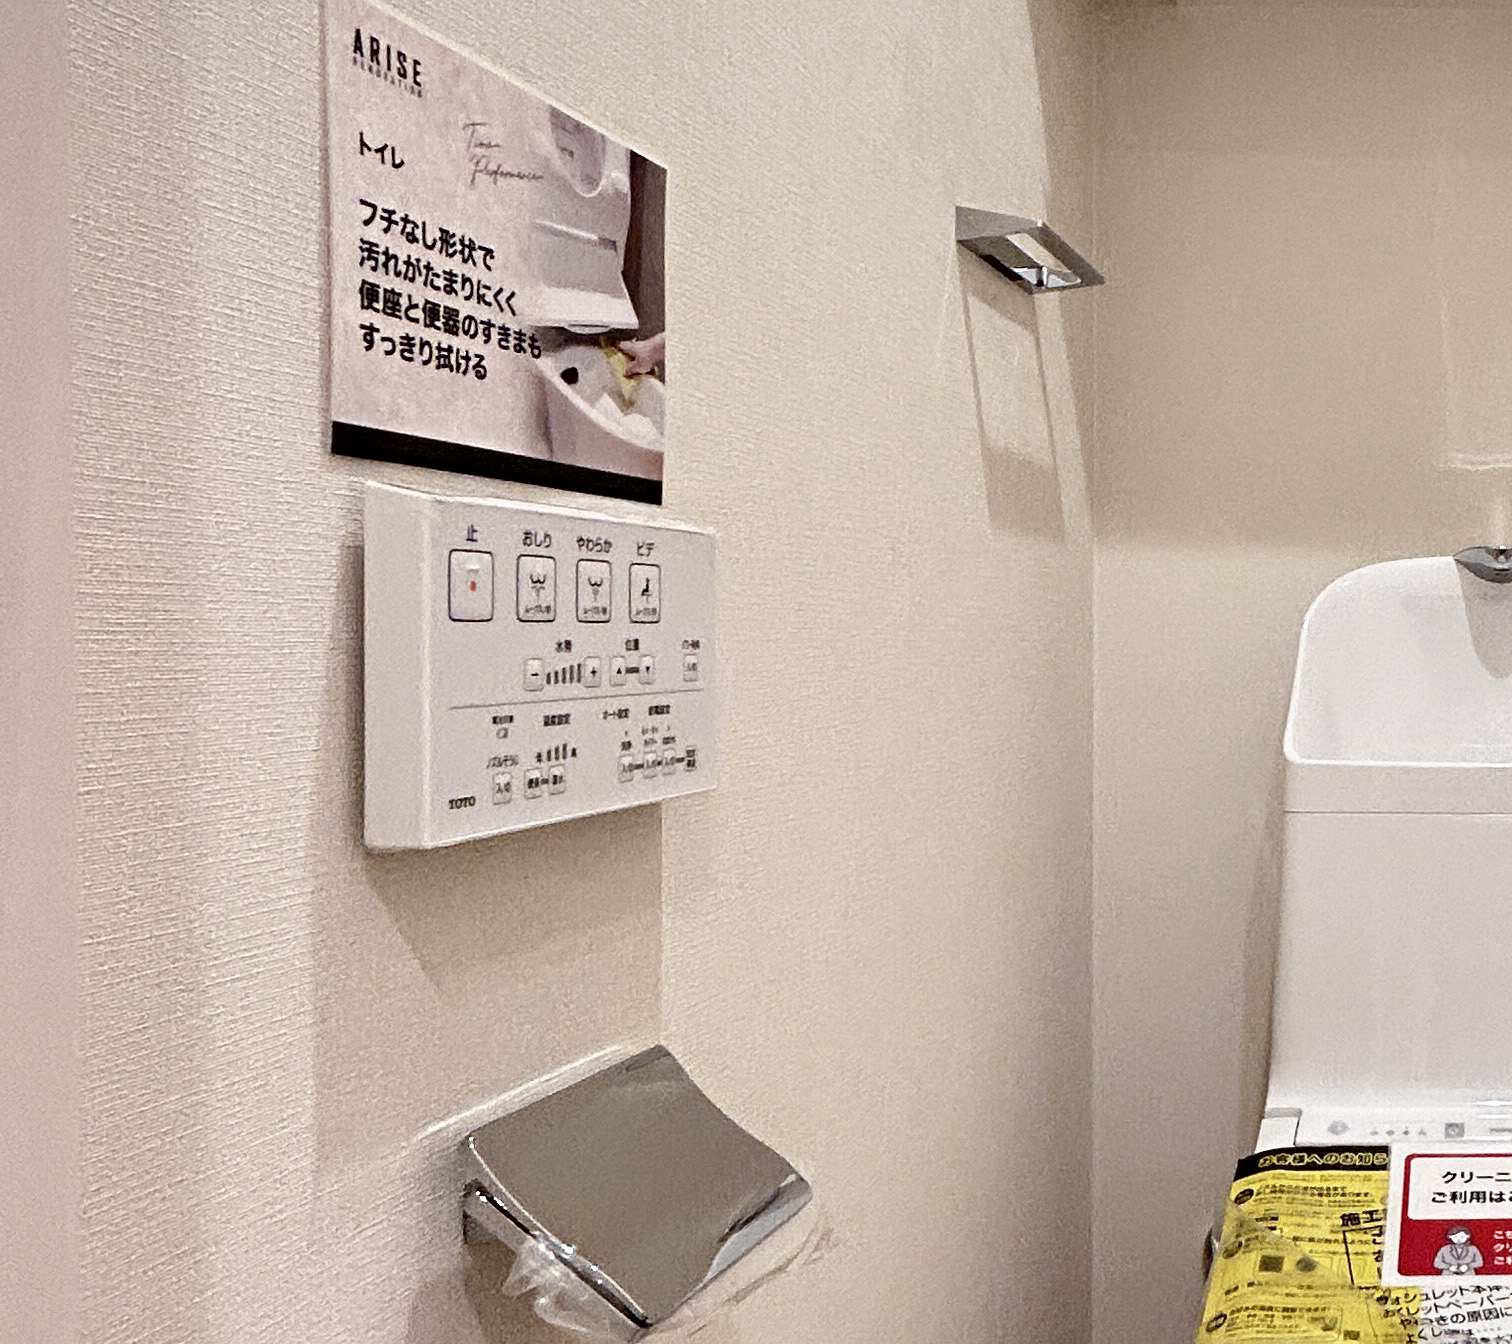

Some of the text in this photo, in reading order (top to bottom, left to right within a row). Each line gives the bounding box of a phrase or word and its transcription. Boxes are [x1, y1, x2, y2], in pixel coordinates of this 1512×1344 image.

[353, 28, 422, 87] ARISE
[359, 131, 405, 169] トイレ
[359, 198, 495, 272] フチなし形状で
[359, 237, 517, 317] 汚れがたまりにくく
[359, 278, 542, 359] 便座と便器のすきまも
[359, 322, 488, 380] すっきり拭ける
[466, 525, 478, 542] 止
[522, 531, 552, 548] おしり
[576, 537, 613, 554] やわらか
[448, 796, 476, 809] TOTO
